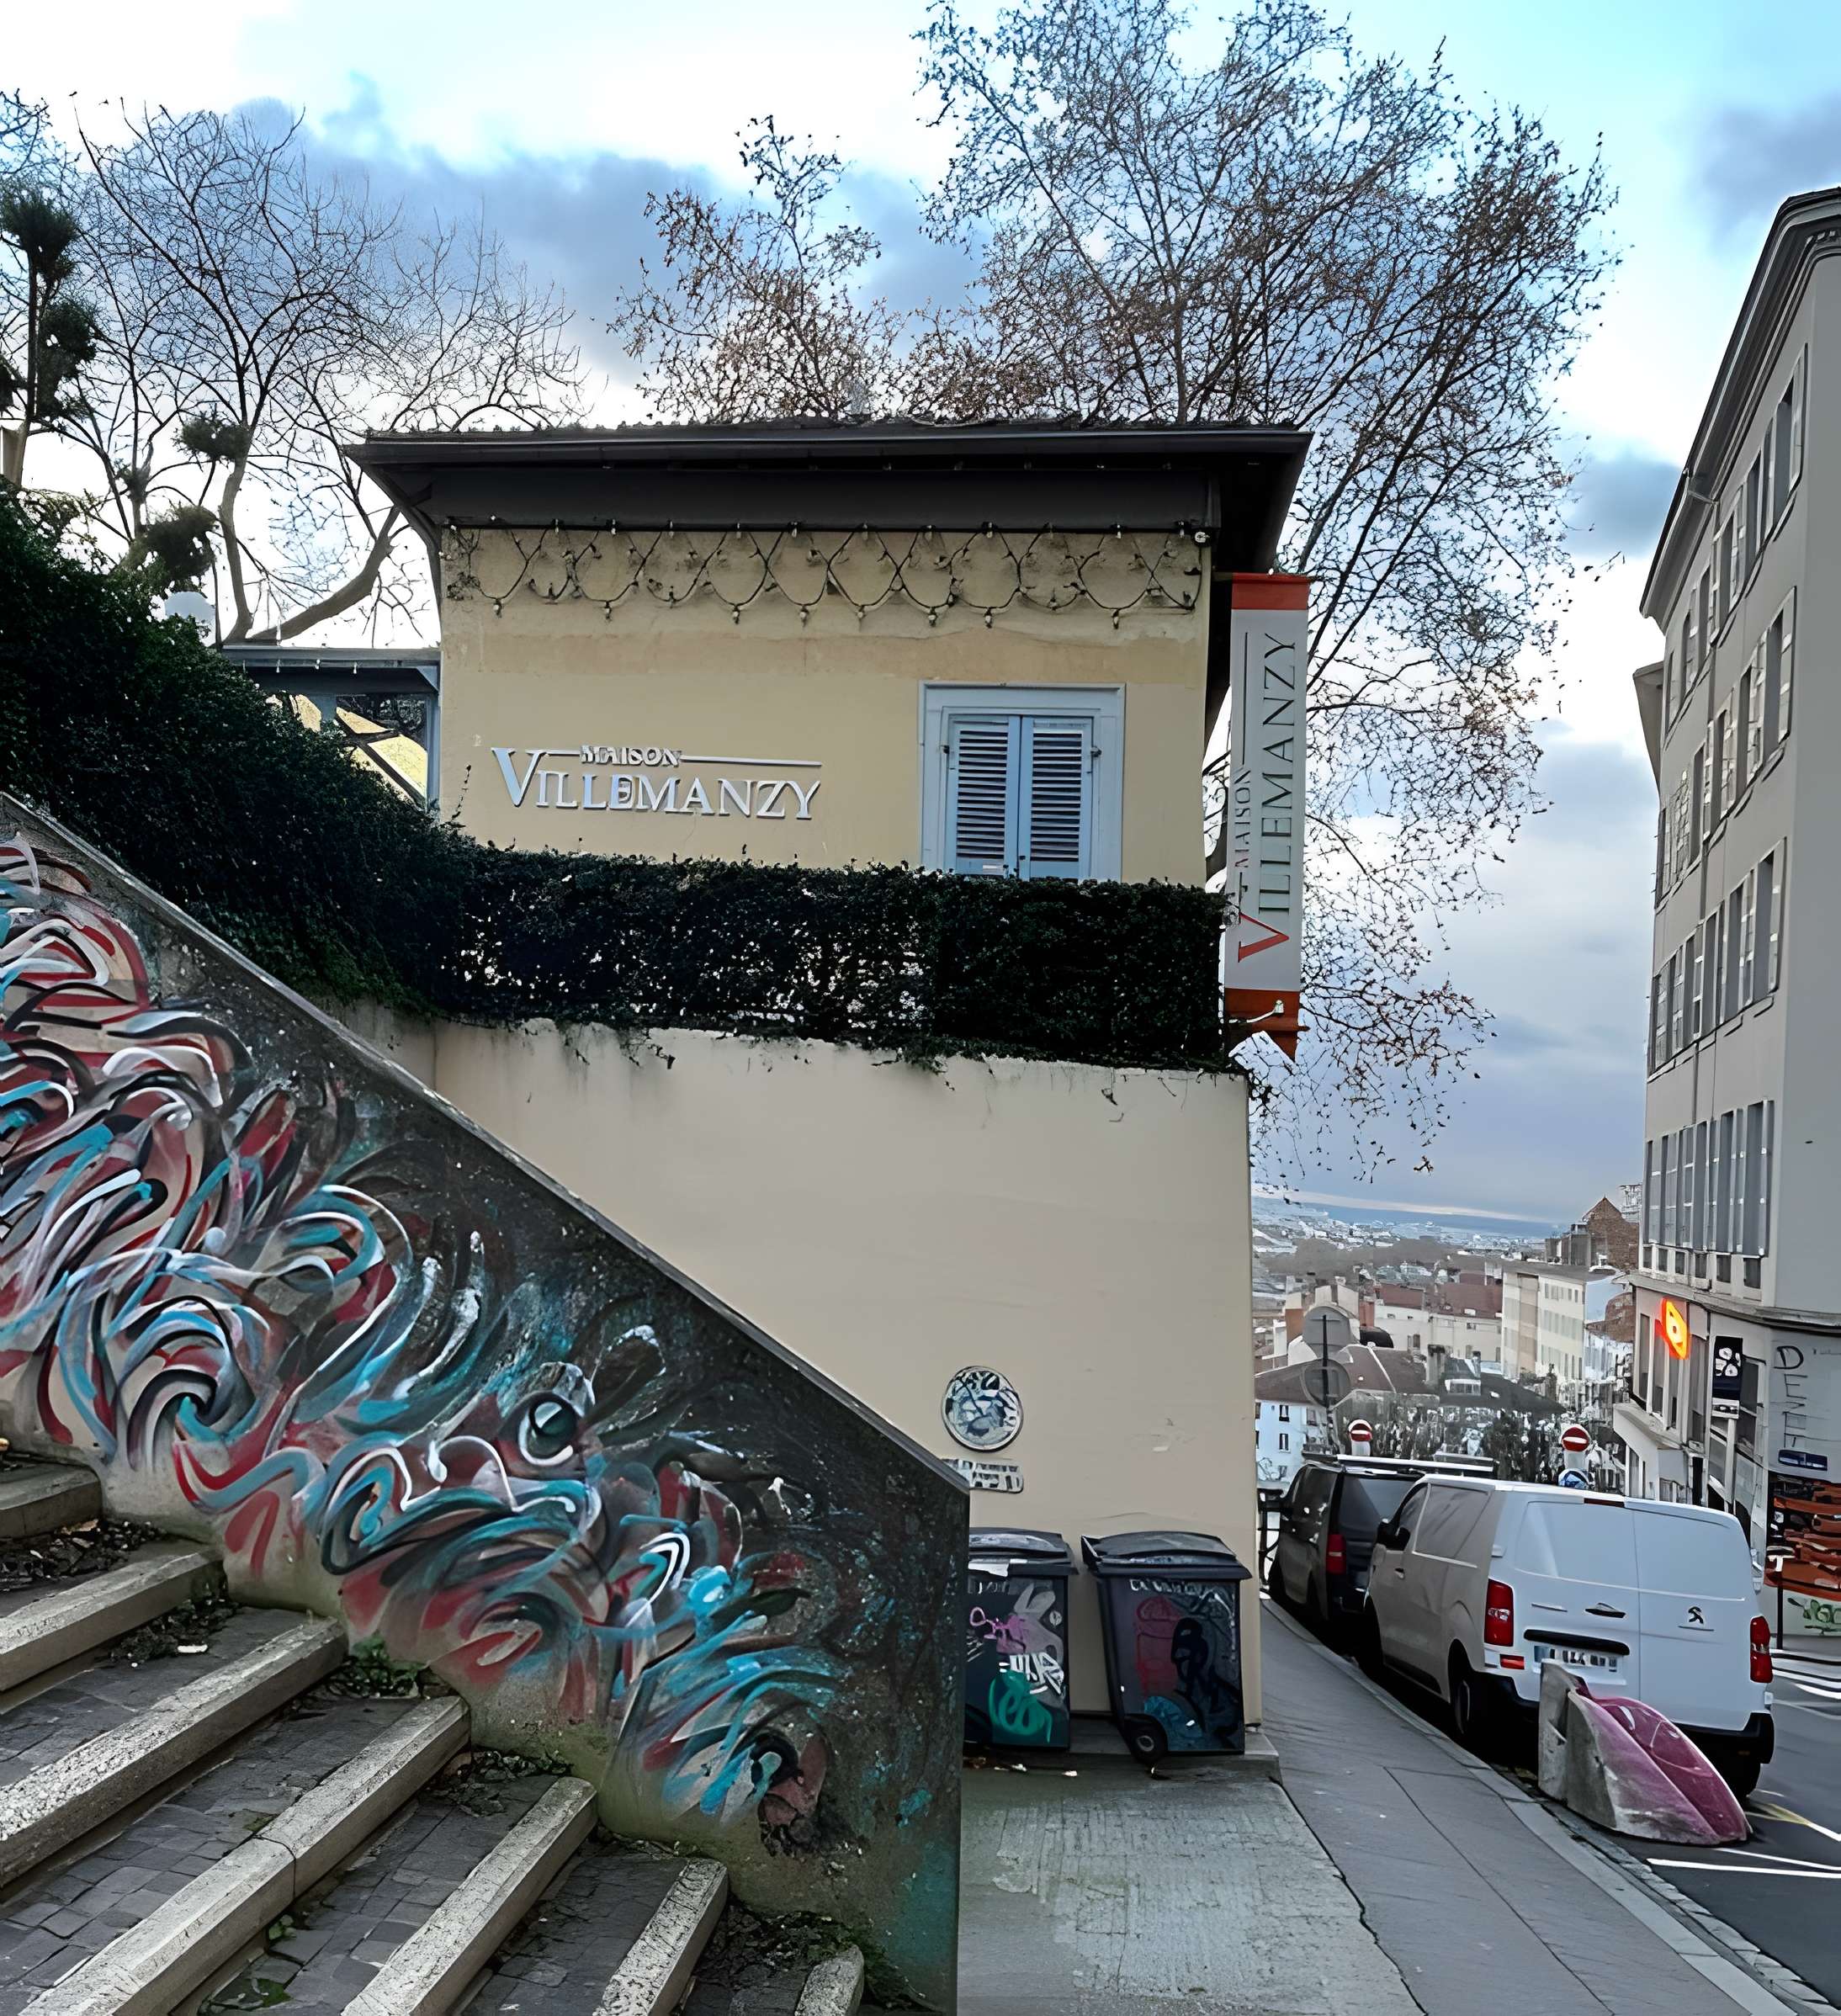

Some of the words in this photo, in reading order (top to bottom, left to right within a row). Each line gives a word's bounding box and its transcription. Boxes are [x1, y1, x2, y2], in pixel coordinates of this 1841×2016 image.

[491, 747, 821, 820] VILLEMANZY
[580, 745, 682, 767] MAISON
[1237, 631, 1296, 964] VILLEMANZY
[1234, 767, 1252, 868] MAISON
